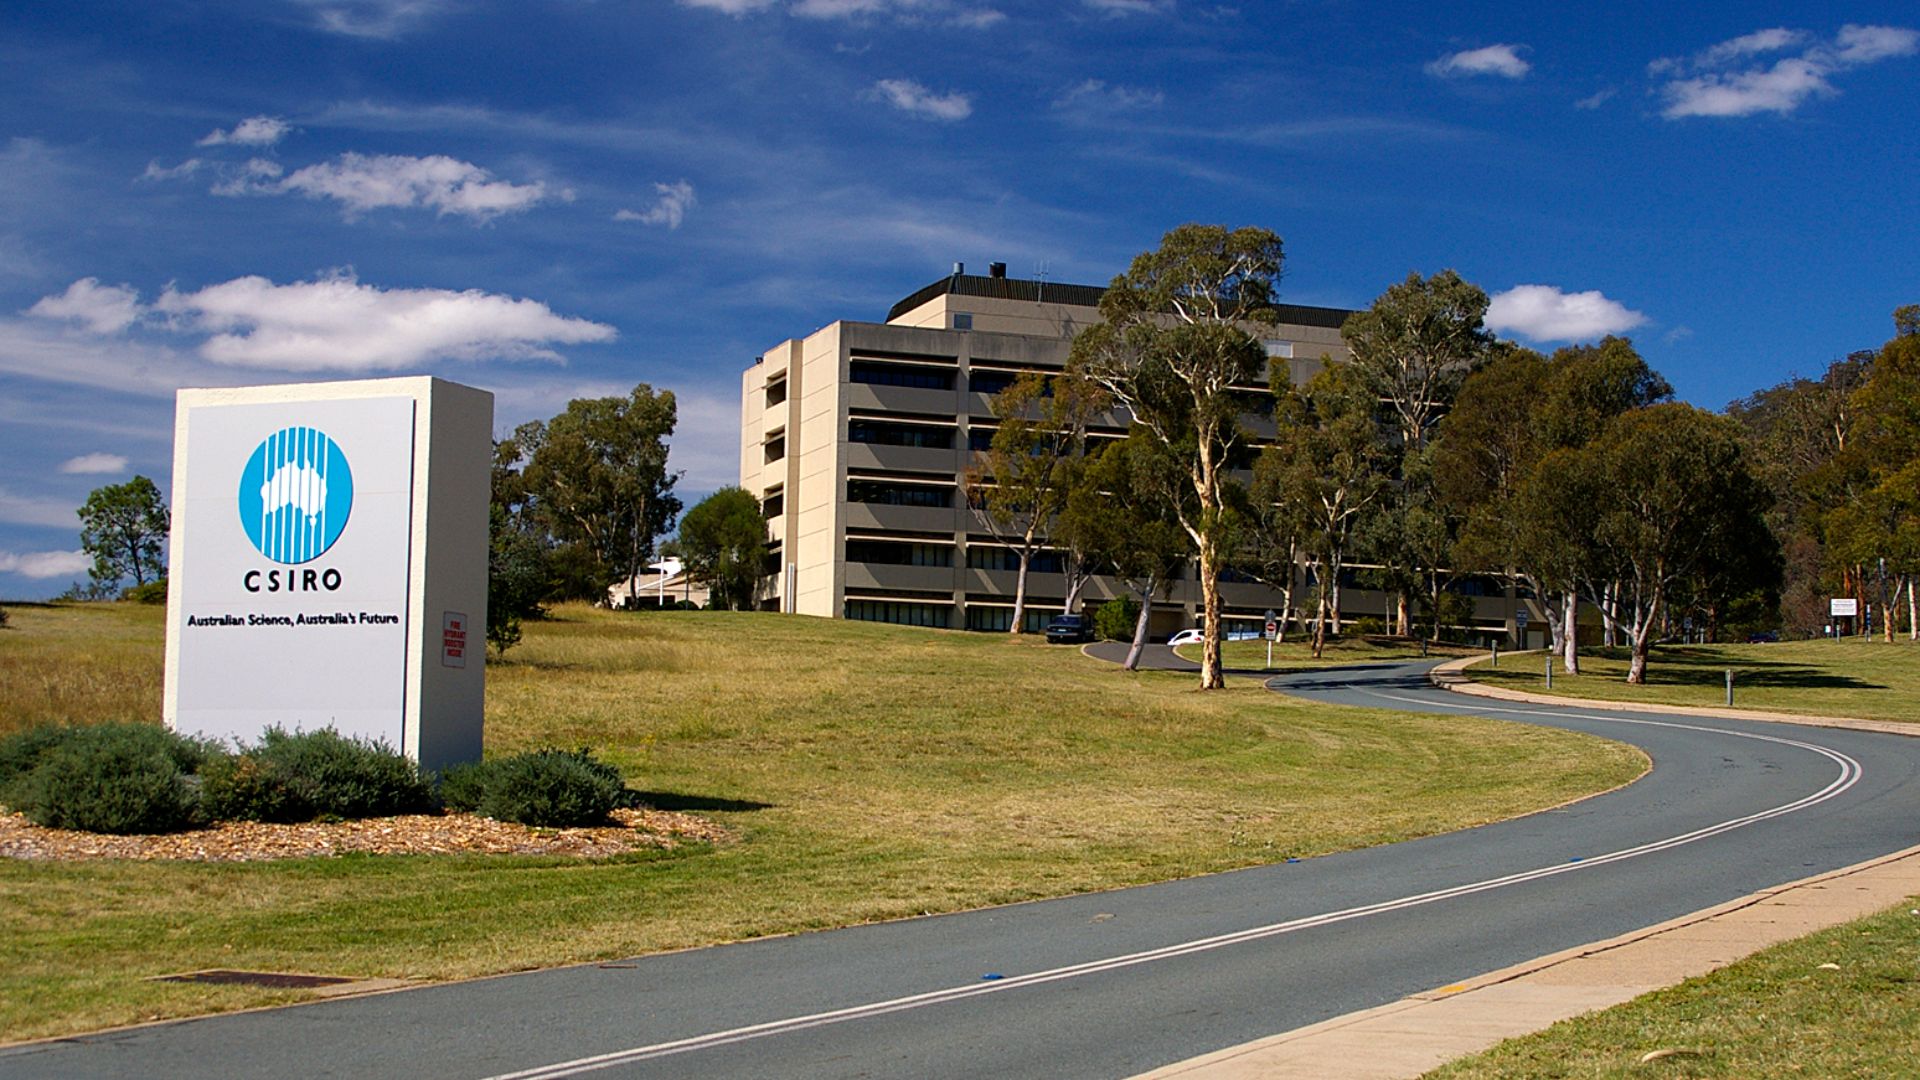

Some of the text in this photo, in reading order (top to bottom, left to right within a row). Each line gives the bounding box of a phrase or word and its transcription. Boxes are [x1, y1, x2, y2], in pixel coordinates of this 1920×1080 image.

[243, 568, 342, 593] CSIRO
[187, 612, 399, 627] Australian Science, Australia's Future
